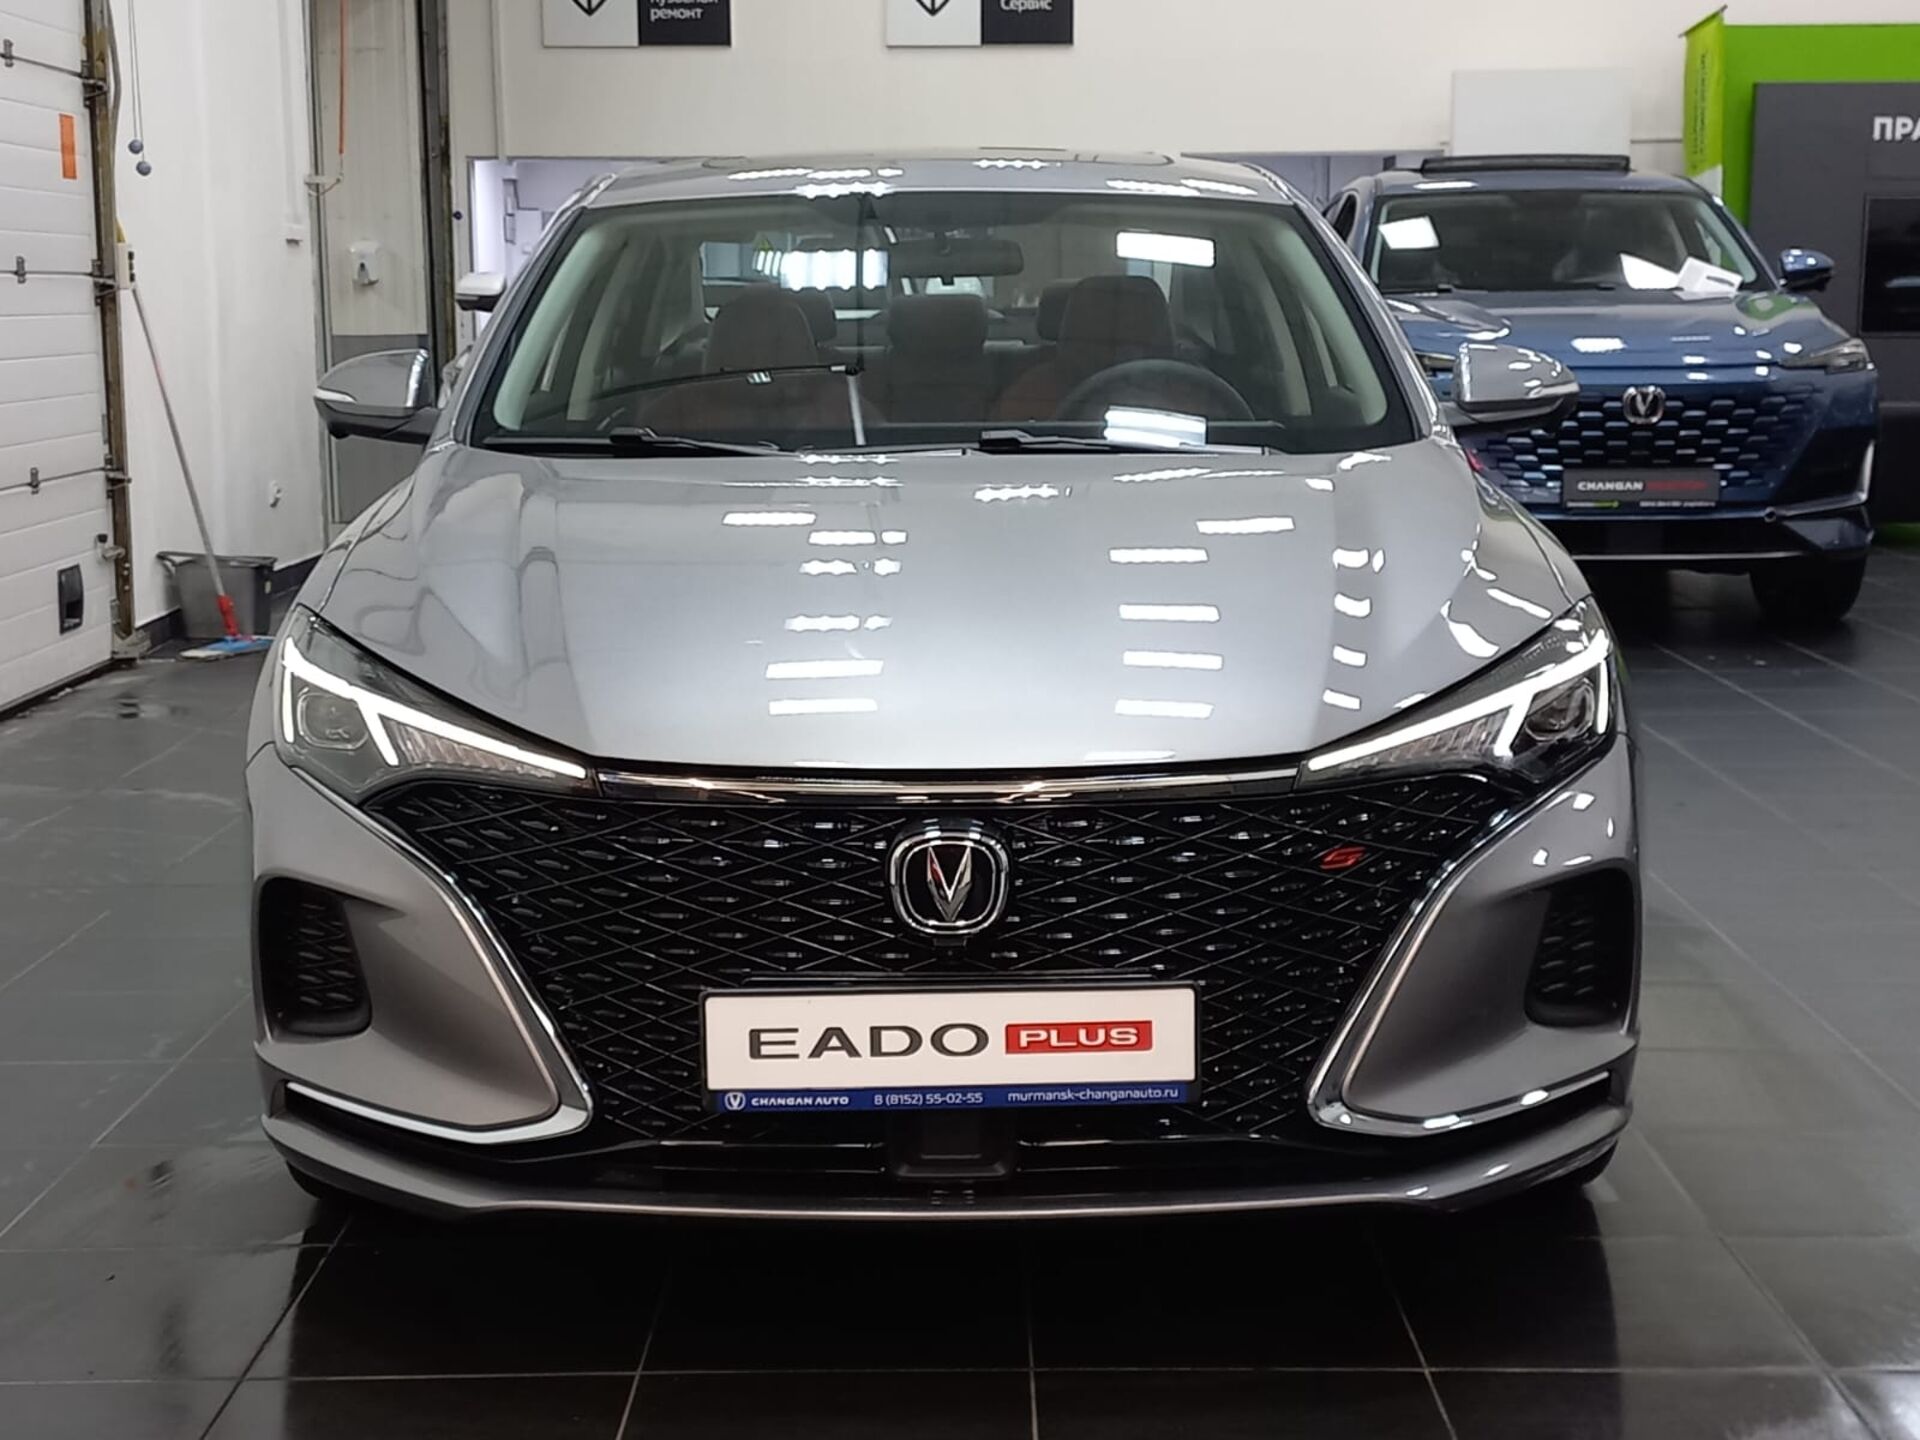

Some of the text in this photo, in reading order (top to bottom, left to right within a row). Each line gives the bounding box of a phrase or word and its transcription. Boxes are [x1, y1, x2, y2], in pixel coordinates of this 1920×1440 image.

[650, 8, 704, 22] ремонт
[749, 1023, 1139, 1060] EADO PLUS
[751, 1096, 812, 1106] CHANGAN
[814, 1096, 849, 1105] AUTO
[885, 1093, 923, 1106] (8152)
[925, 1092, 983, 1104] 55-02-55
[1007, 1088, 1179, 1102] murmansk-changanauto.ru
